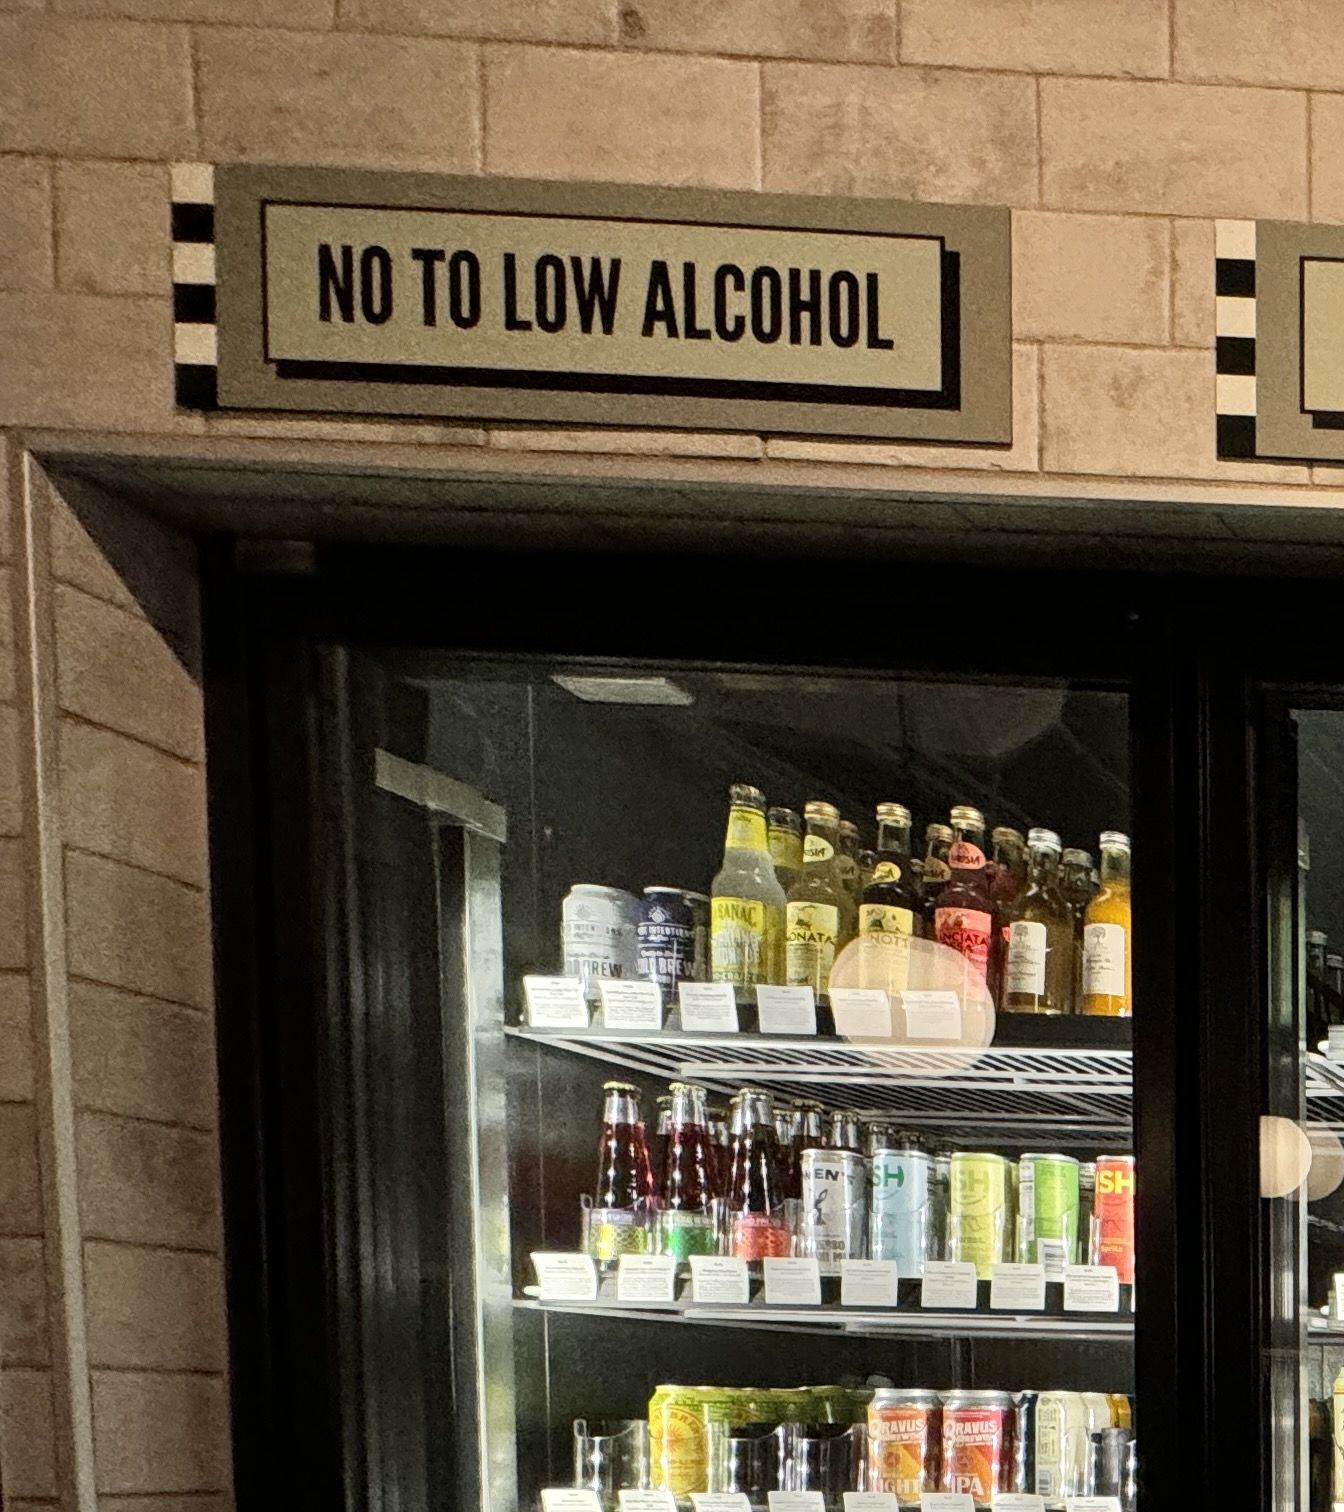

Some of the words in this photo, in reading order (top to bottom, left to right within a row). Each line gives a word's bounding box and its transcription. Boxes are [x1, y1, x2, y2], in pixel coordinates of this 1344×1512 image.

[317, 243, 394, 327] NO
[411, 247, 481, 329] TO
[503, 252, 621, 336] LOW
[640, 260, 894, 352] ALCOHOL
[950, 1476, 985, 1495] IPA
